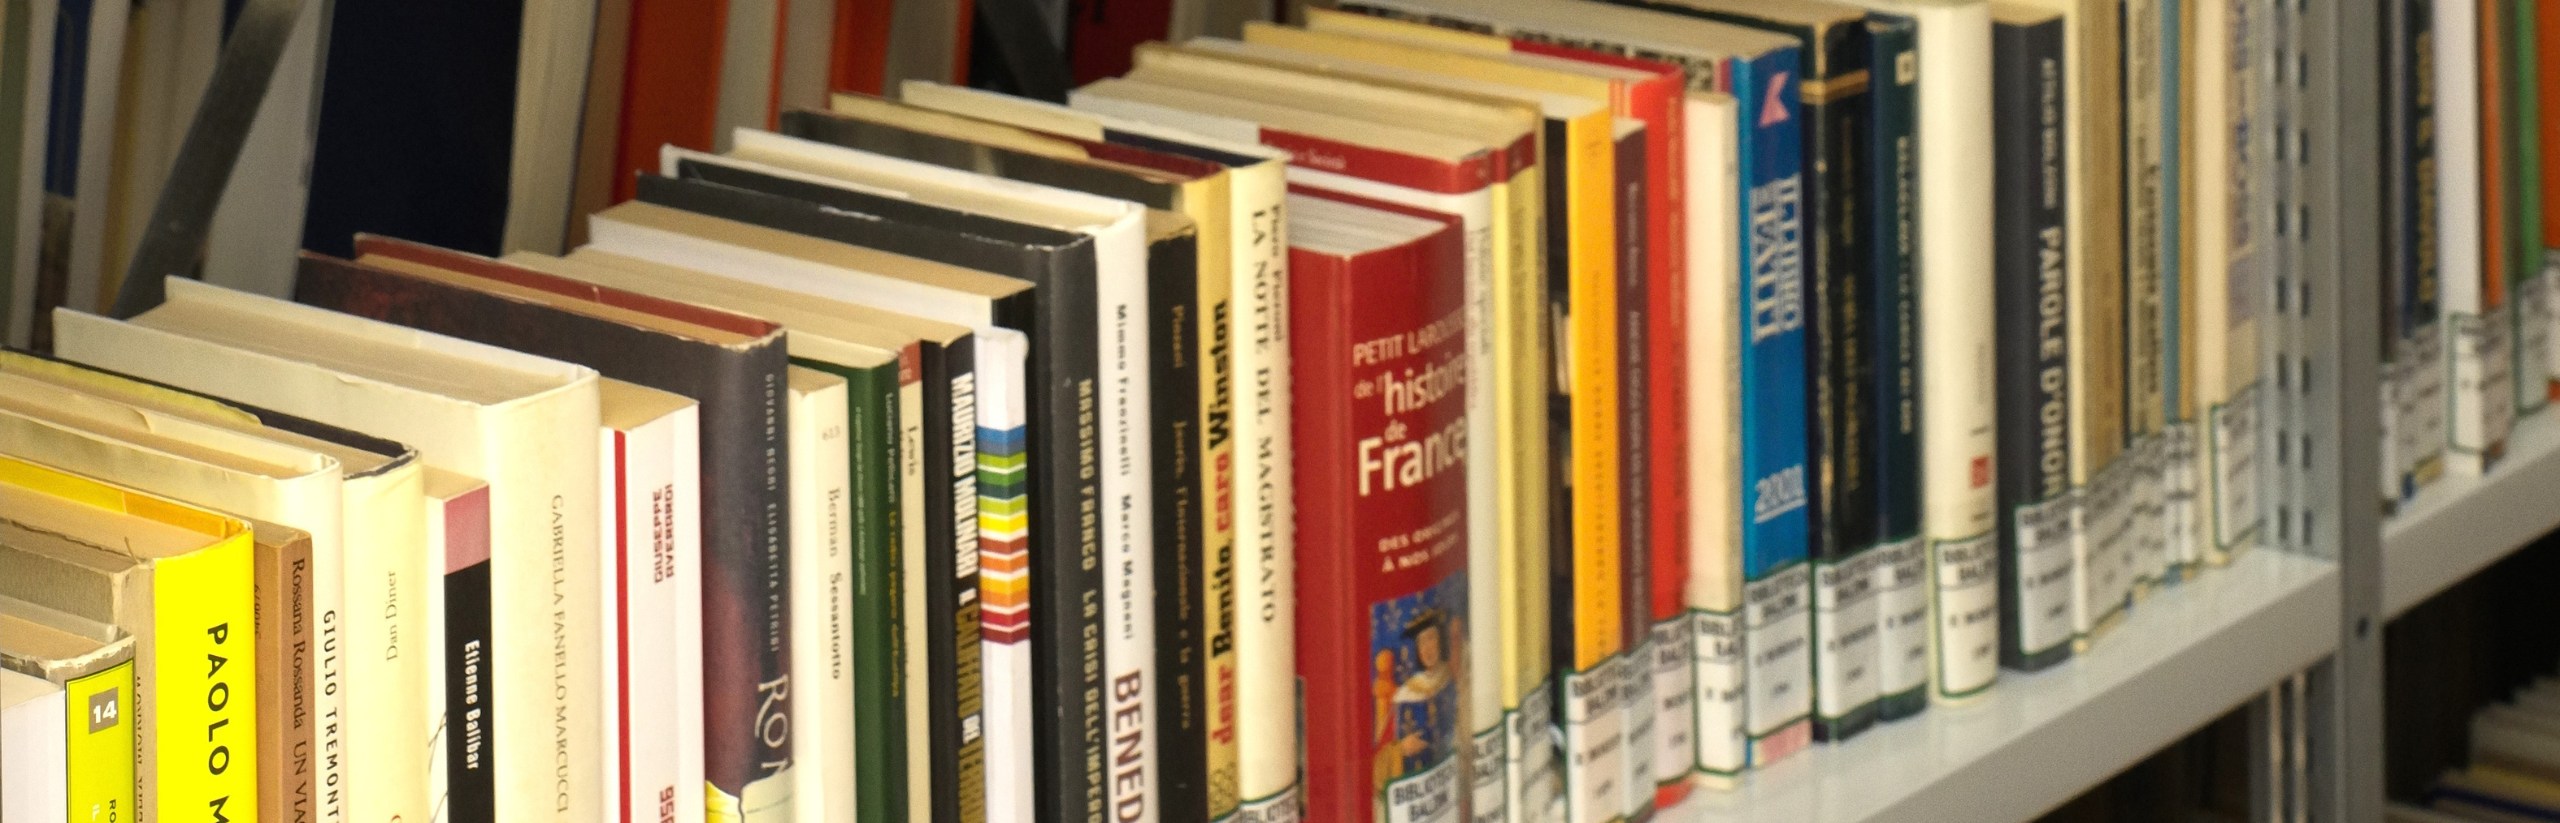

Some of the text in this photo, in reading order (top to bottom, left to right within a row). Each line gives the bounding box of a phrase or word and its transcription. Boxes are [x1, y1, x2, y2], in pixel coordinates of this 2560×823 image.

[2039, 226, 2064, 362] PAROLE
[1208, 301, 1230, 451] Winston
[1353, 334, 1404, 367] PETIT
[1354, 380, 1375, 400] de
[765, 373, 776, 441] GIOVANNI
[951, 371, 976, 478] MAURIZIO
[1078, 378, 1095, 480] MASSIMO
[1253, 210, 1276, 623] LA NOTTE DEL MAGISTRATO
[1384, 419, 1408, 443] de
[1117, 304, 1134, 640] Mimmo Franzinelli Marco Magnani
[1215, 452, 1232, 533] caro
[1358, 416, 1467, 496] France
[653, 488, 663, 583] GIUSEPPE
[664, 484, 674, 580] AVERARDI
[766, 503, 778, 589] ELISABETTA
[954, 474, 979, 579] MOLINARI
[1080, 485, 1097, 571] FRANCO
[385, 571, 398, 662] Dan Diner
[828, 488, 843, 680] Berman Sessantotto
[1083, 589, 1098, 619] LA
[207, 622, 230, 776] PAOLO
[292, 558, 308, 823] Rossana Rossanda UN VIA
[551, 494, 569, 814] GABRIELLA FANELLO MARCUCCI
[1083, 623, 1099, 683] CRISI
[93, 700, 117, 724] 14
[323, 610, 340, 823] GIULIO TREMONT
[465, 639, 481, 769] Etienne Balibar
[962, 713, 981, 745] DEL
[1114, 668, 1145, 823] BENED
[1211, 665, 1235, 745] dear
